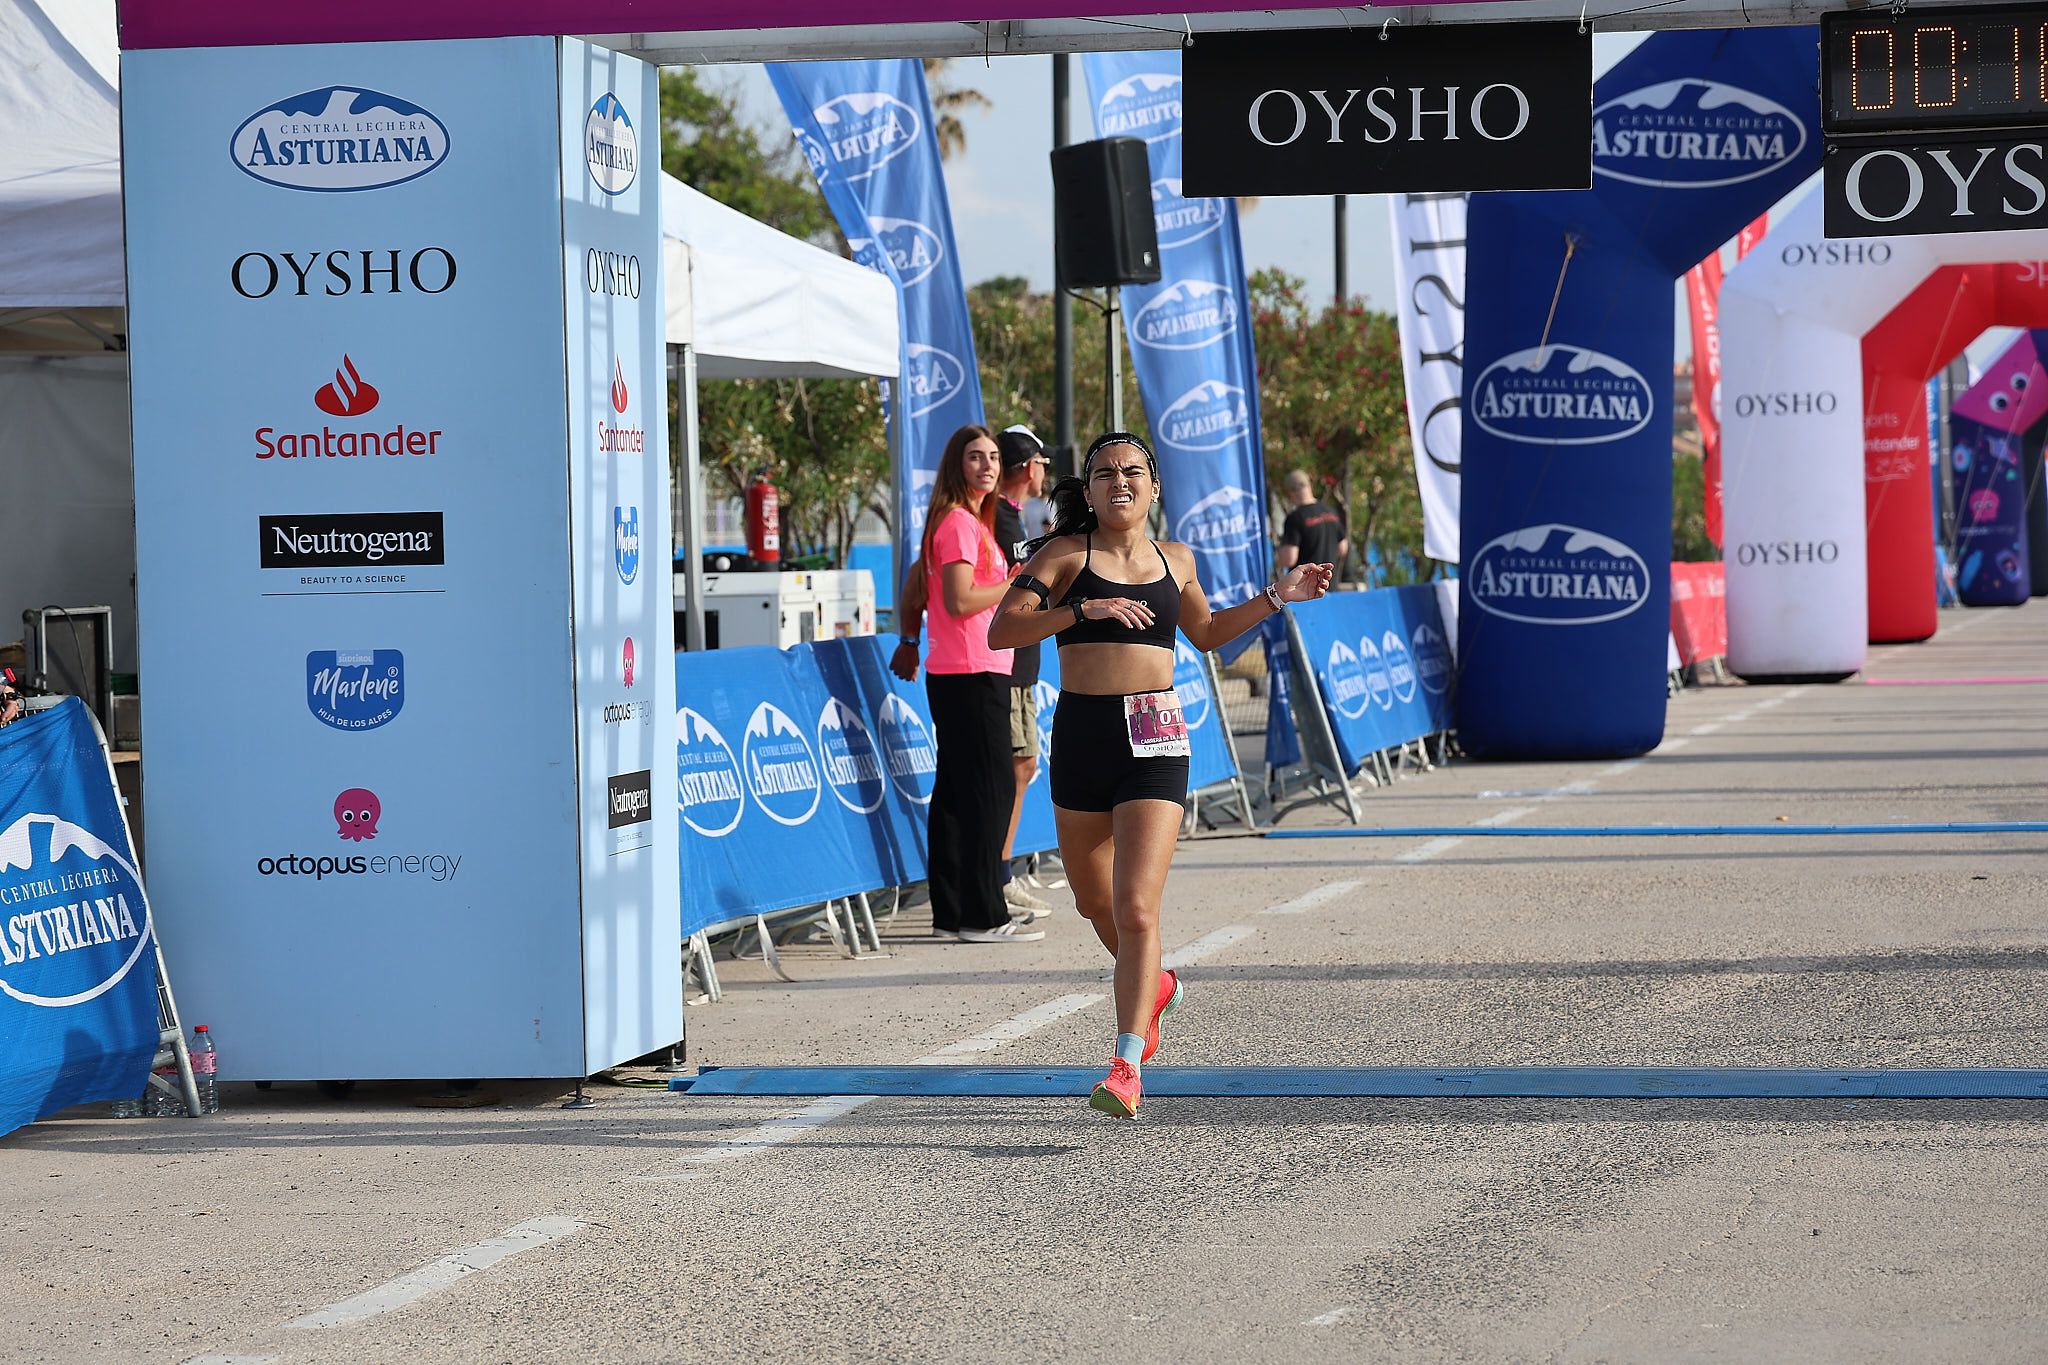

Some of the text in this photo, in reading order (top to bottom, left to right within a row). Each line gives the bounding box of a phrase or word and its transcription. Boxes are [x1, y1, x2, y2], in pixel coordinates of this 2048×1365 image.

[280, 120, 426, 135] CENTRAL LECHERA
[1248, 83, 1530, 146] OYSHO
[1618, 115, 1784, 129] CENTRAL LECHERA
[247, 127, 435, 167] ASTURIANA
[589, 125, 634, 173] ASTURIANA
[1593, 118, 1786, 161] ASTURIANA
[1781, 241, 1892, 267] OYSHO
[231, 247, 457, 299] OYSHO
[587, 247, 641, 300] OYSHO
[1503, 378, 1638, 392] CENTRAL LECHERA
[1480, 381, 1643, 422] ASTURIANA
[1735, 389, 1838, 418] OYSHO
[255, 424, 442, 460] Santander
[598, 420, 645, 453] Santander
[1500, 556, 1635, 571] CENTRAL LECHERA
[1737, 539, 1839, 568] OYSHO
[300, 574, 406, 585] BEAUTY TO A SCIENCE
[1476, 559, 1639, 602] ASTURIANA
[317, 707, 393, 728] HIJA DE LOS ALPES
[750, 749, 817, 797] ASTURIANA
[610, 786, 649, 818] Neutrogena
[60, 866, 119, 893] LECHERA
[257, 853, 462, 882] octopus energy
